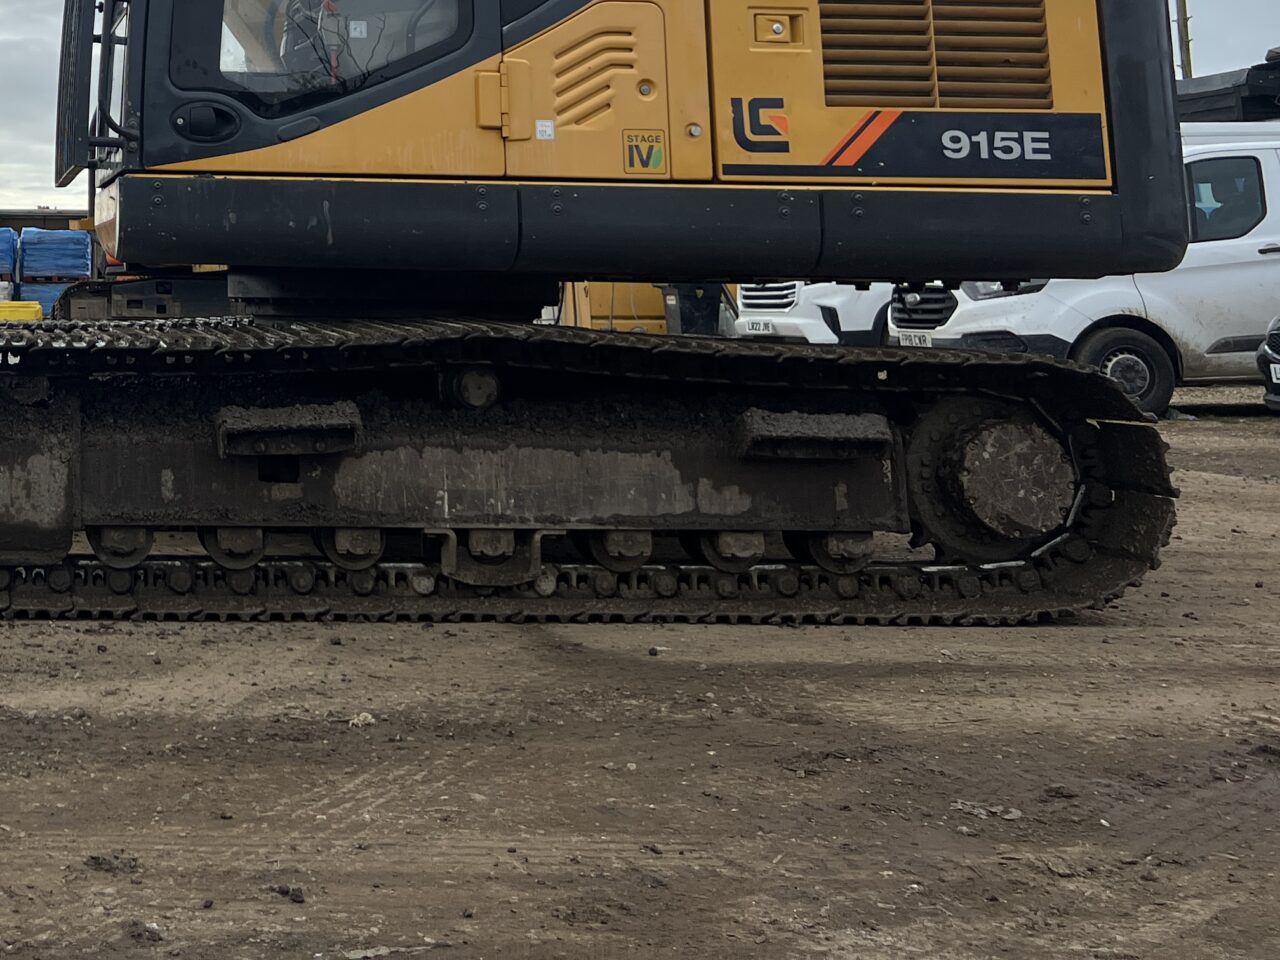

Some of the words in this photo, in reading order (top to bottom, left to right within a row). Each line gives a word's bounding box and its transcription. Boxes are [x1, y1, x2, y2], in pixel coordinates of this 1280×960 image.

[627, 135, 662, 143] STAGE
[941, 130, 1052, 160] 915E
[628, 144, 654, 169] IV
